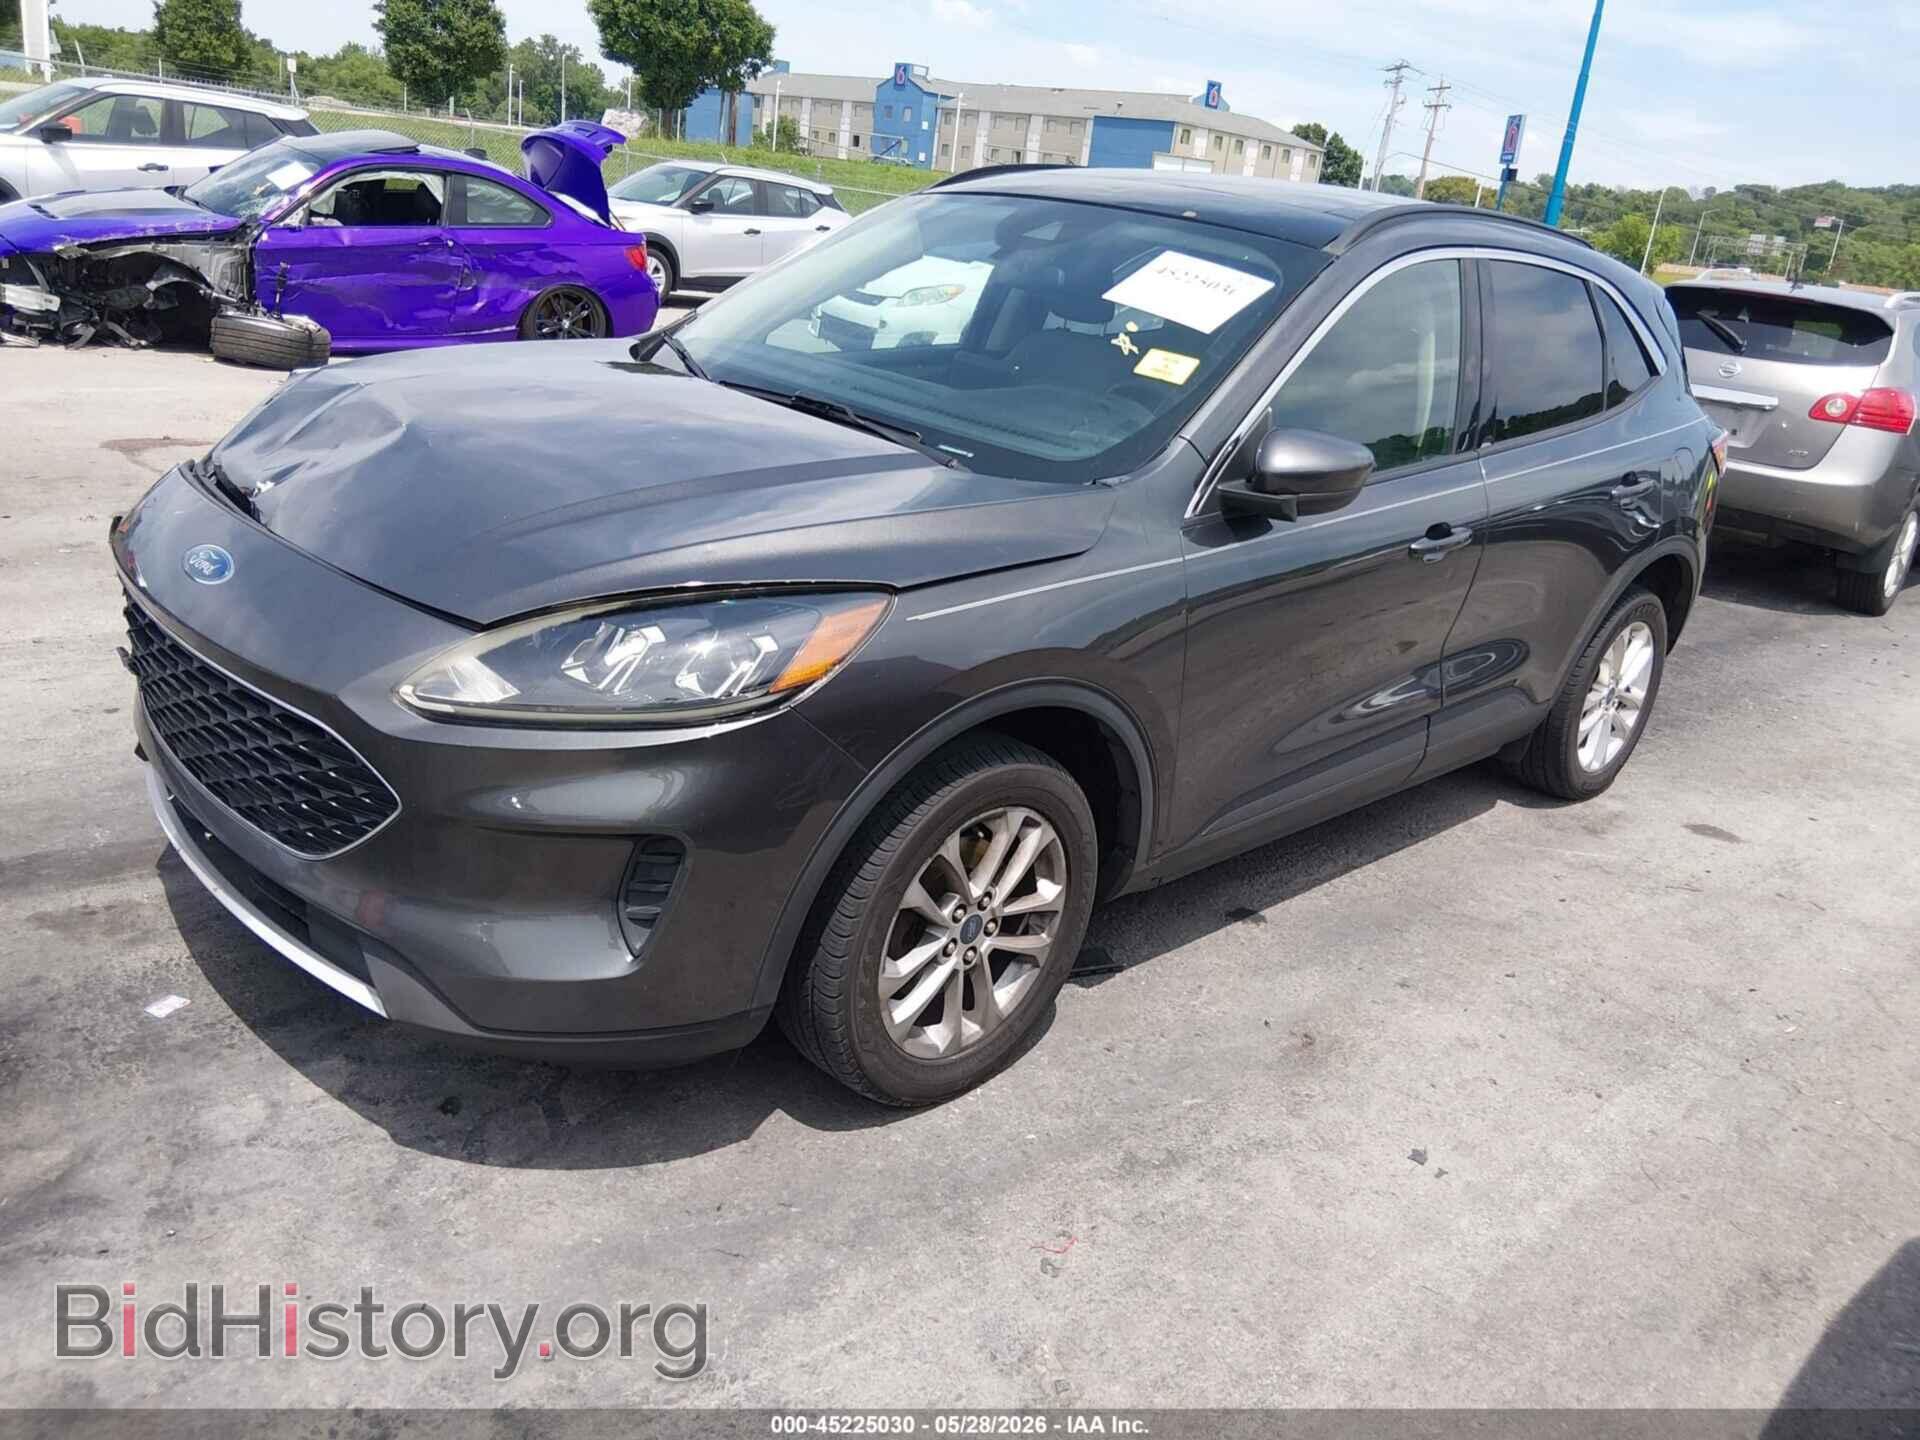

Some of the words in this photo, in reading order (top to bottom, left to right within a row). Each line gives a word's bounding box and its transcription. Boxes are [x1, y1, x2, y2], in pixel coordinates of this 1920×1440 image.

[896, 65, 905, 85] 6
[1208, 86, 1219, 106] 6
[189, 551, 221, 576] Ford
